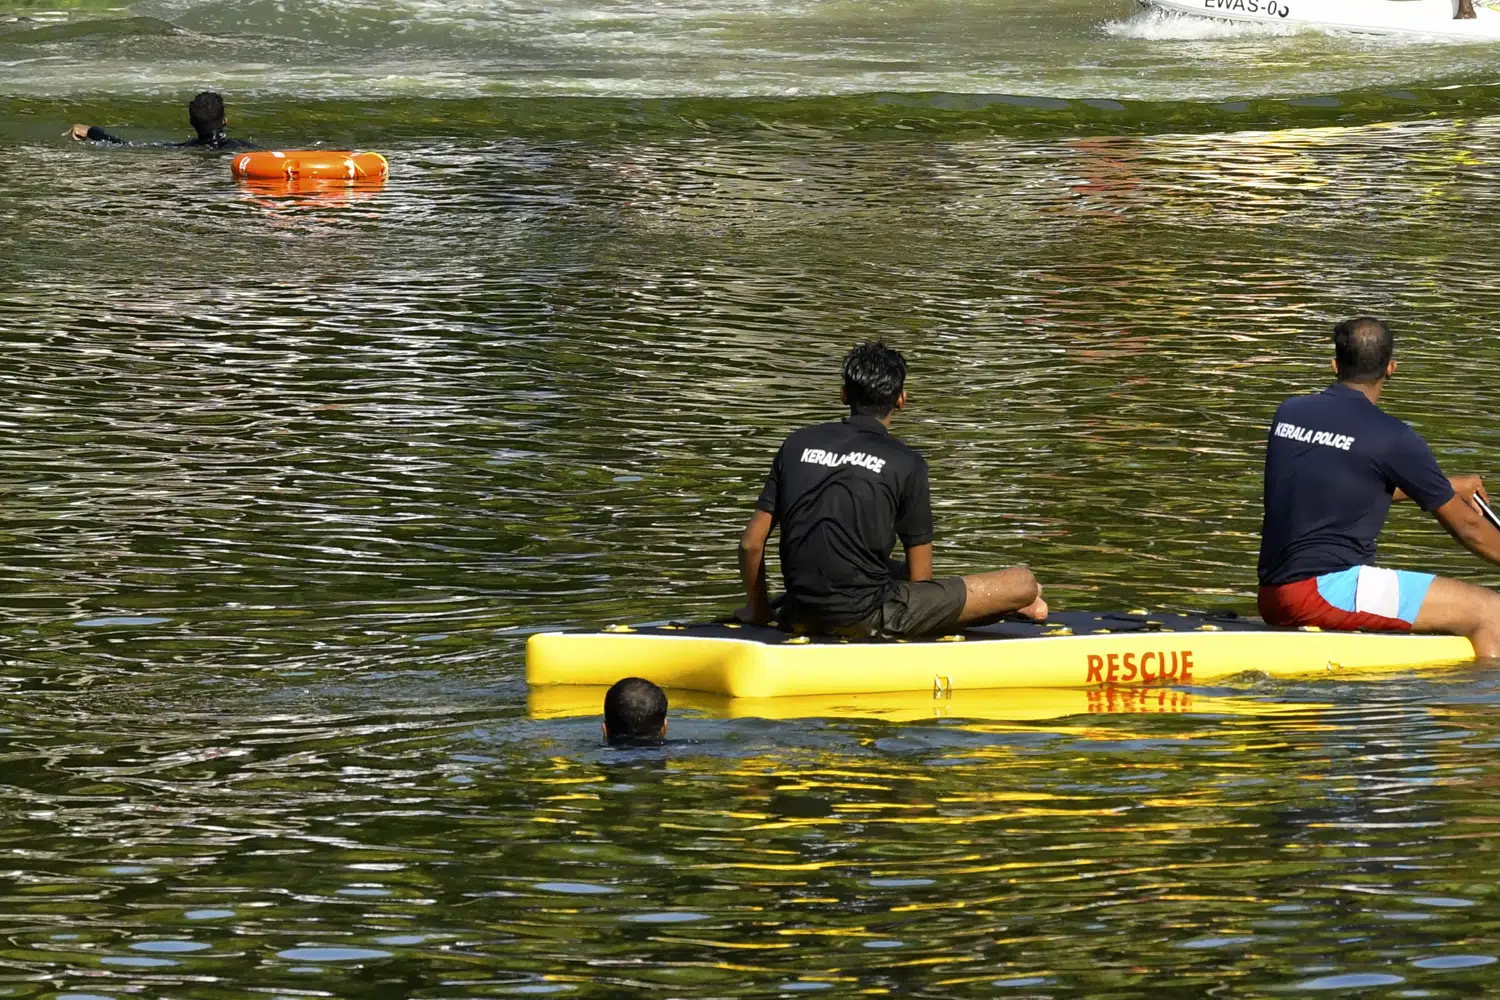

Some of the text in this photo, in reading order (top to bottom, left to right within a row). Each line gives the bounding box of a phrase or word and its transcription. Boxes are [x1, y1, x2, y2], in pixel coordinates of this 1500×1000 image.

[1274, 421, 1356, 451] KERALA POLICE
[1085, 650, 1194, 684] RESCUE
